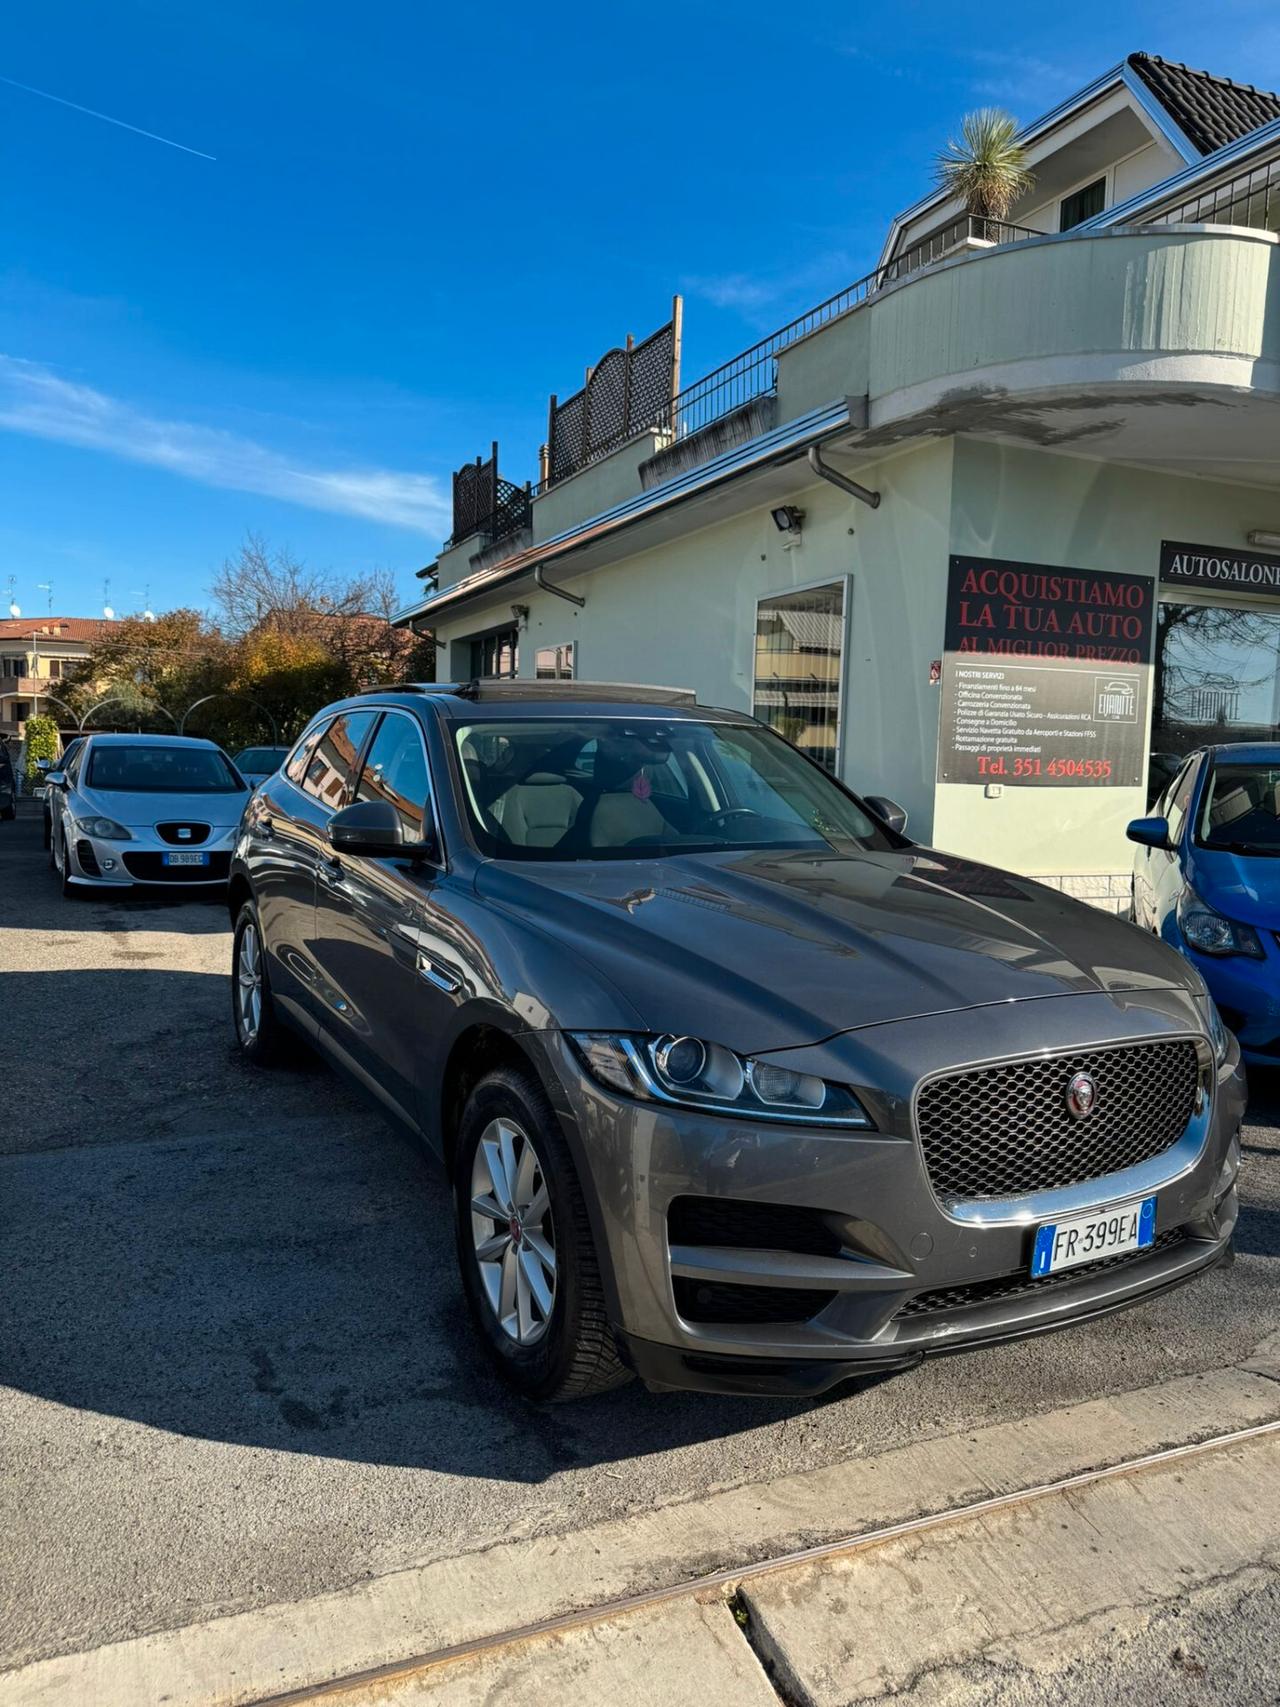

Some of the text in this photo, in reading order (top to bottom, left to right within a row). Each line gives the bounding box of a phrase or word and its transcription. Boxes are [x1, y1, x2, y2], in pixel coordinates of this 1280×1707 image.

[960, 567, 1145, 609] ACQUISTIAMO
[958, 601, 1143, 640] LA TUA AUTO
[959, 636, 1142, 665] AL MIGLIOR PREZZO
[982, 672, 1005, 680] SERVIZI
[981, 692, 1023, 700] Convenzionata
[990, 701, 1031, 709] Convenzionata
[957, 708, 977, 716] Polizze
[956, 726, 979, 734] Servizio
[955, 743, 980, 752] Passaggi
[977, 756, 1112, 778] Tel. 351 4504535
